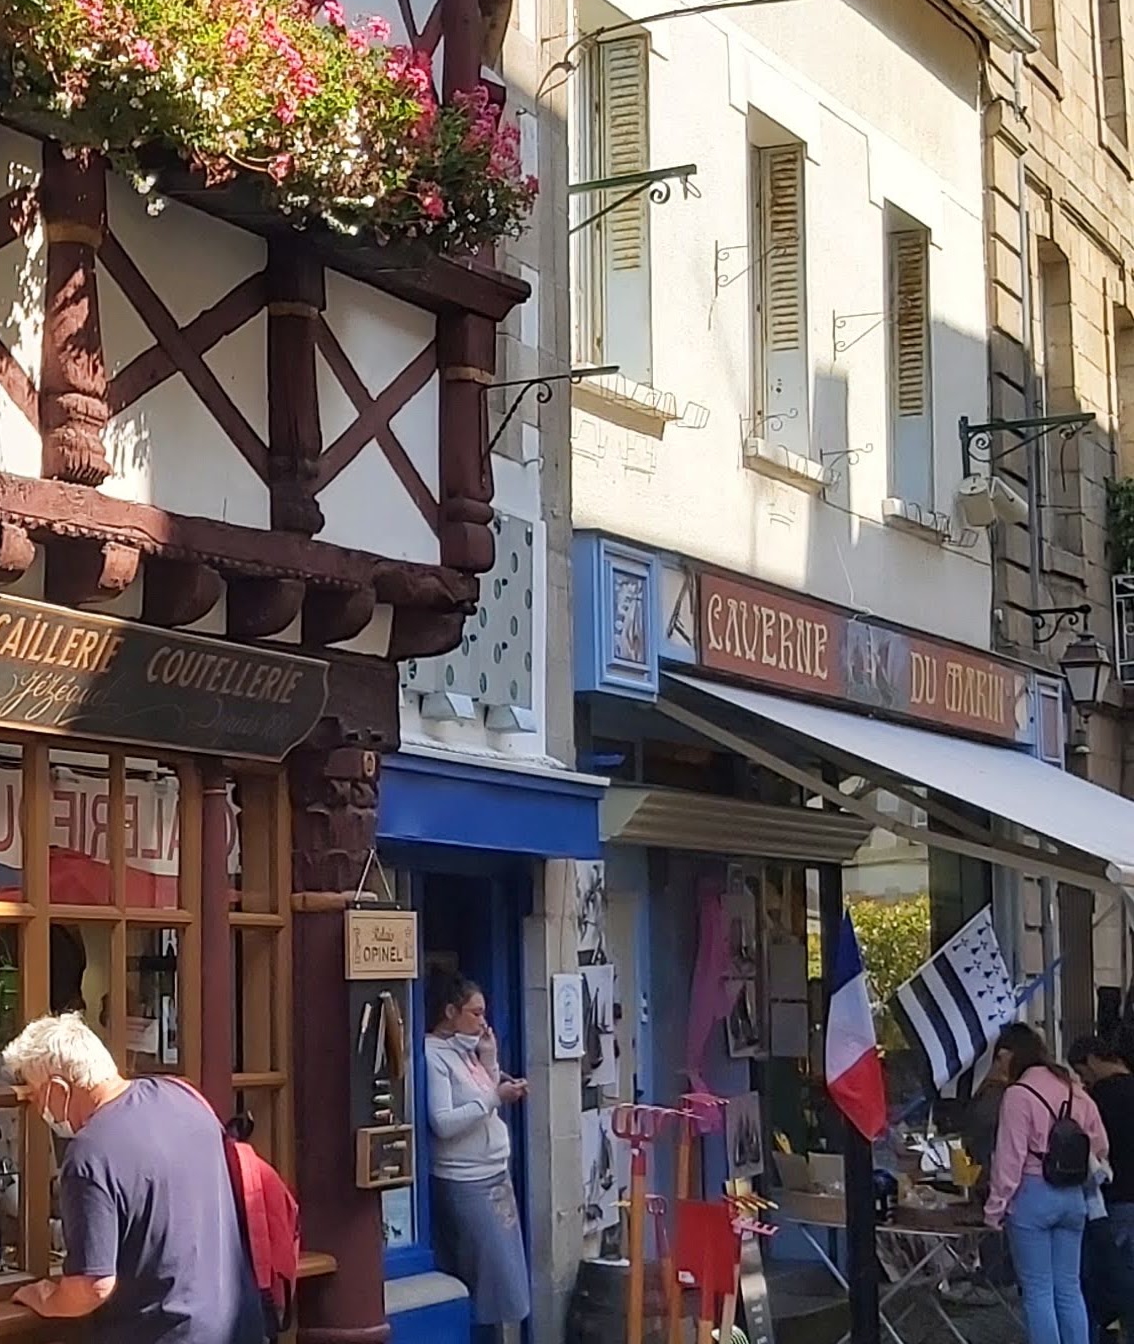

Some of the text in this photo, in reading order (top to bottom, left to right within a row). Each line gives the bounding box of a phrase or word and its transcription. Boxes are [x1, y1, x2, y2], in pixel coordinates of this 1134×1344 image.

[147, 645, 303, 705] COUTELLERIE
[707, 592, 1004, 724] CAVERNE DU MARIN
[363, 946, 403, 963] OPINEL
